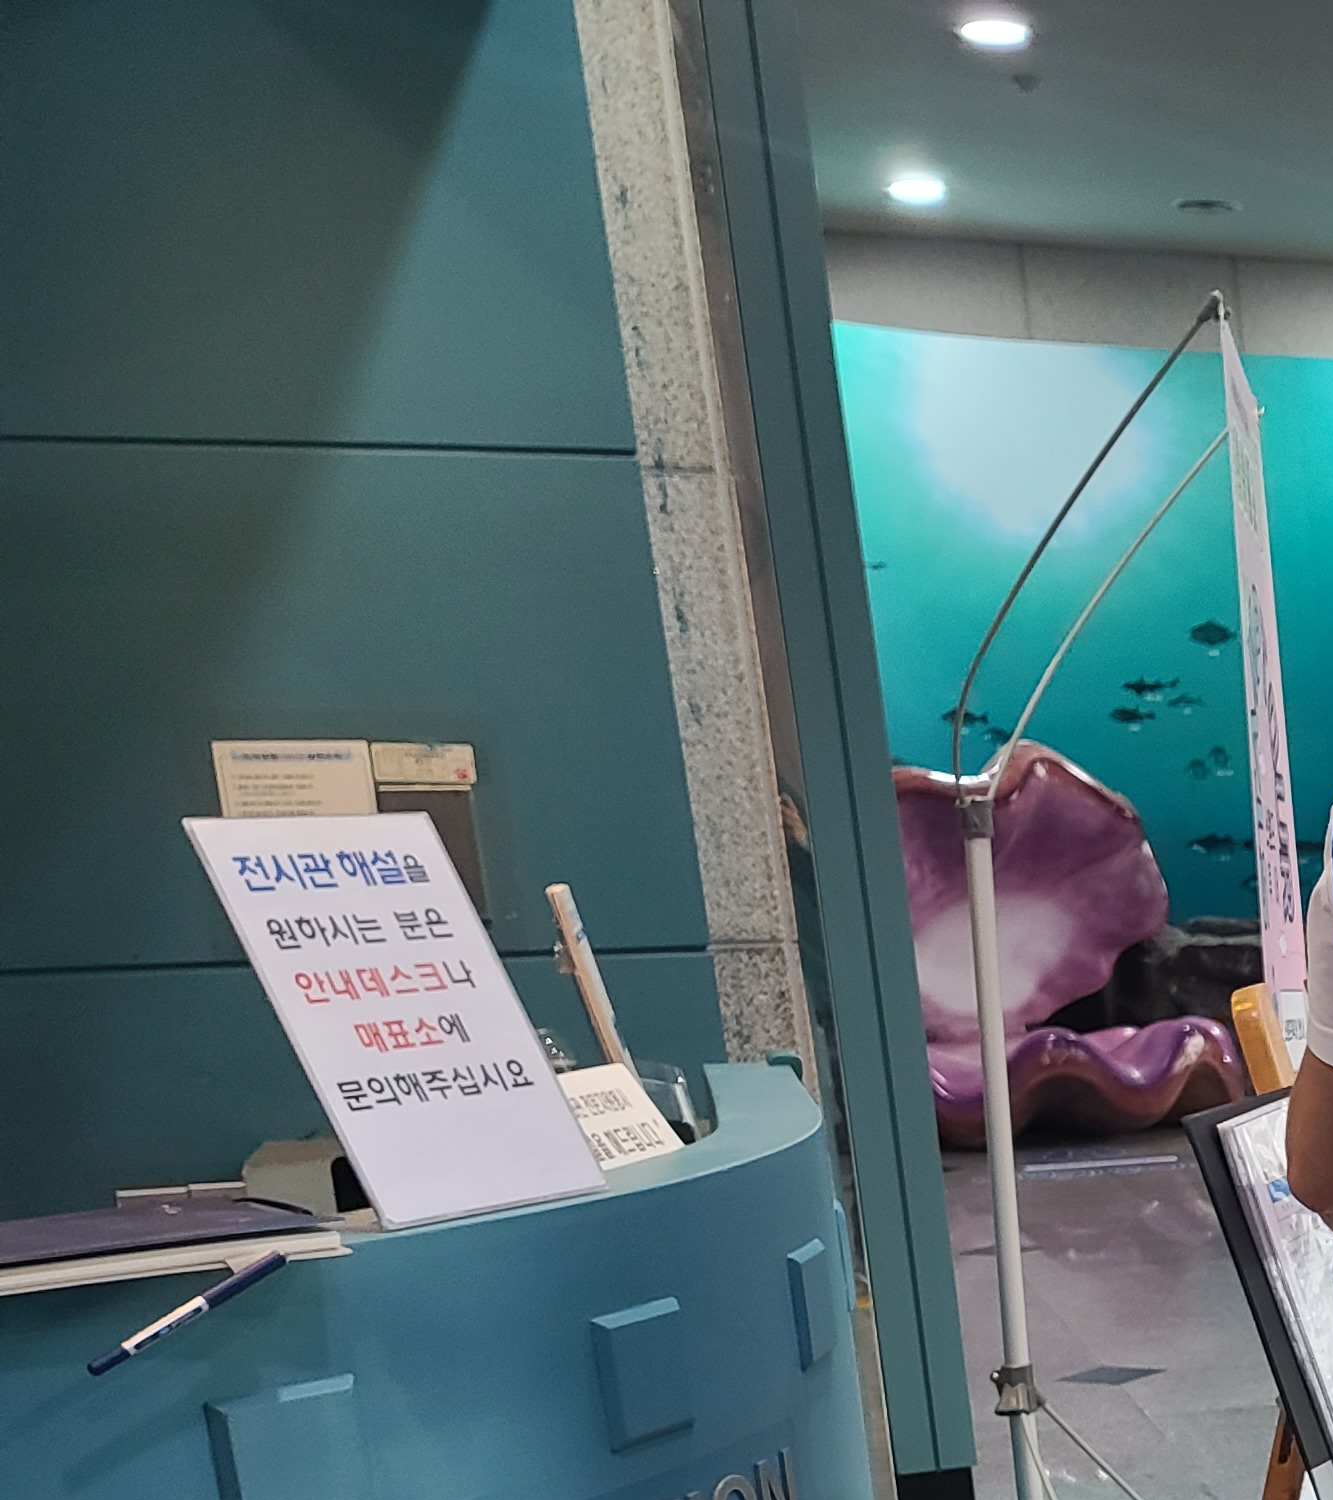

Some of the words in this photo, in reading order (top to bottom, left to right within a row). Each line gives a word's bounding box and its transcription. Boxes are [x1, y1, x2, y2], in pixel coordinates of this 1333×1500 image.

[232, 852, 338, 892] 전시관
[338, 849, 431, 886] 해설을
[266, 914, 388, 950] 원하시는
[393, 907, 454, 941] 분은
[294, 960, 477, 1004] 안내데스크나
[354, 1012, 471, 1054] 매표소에
[336, 1059, 534, 1112] 문의해주십시요
